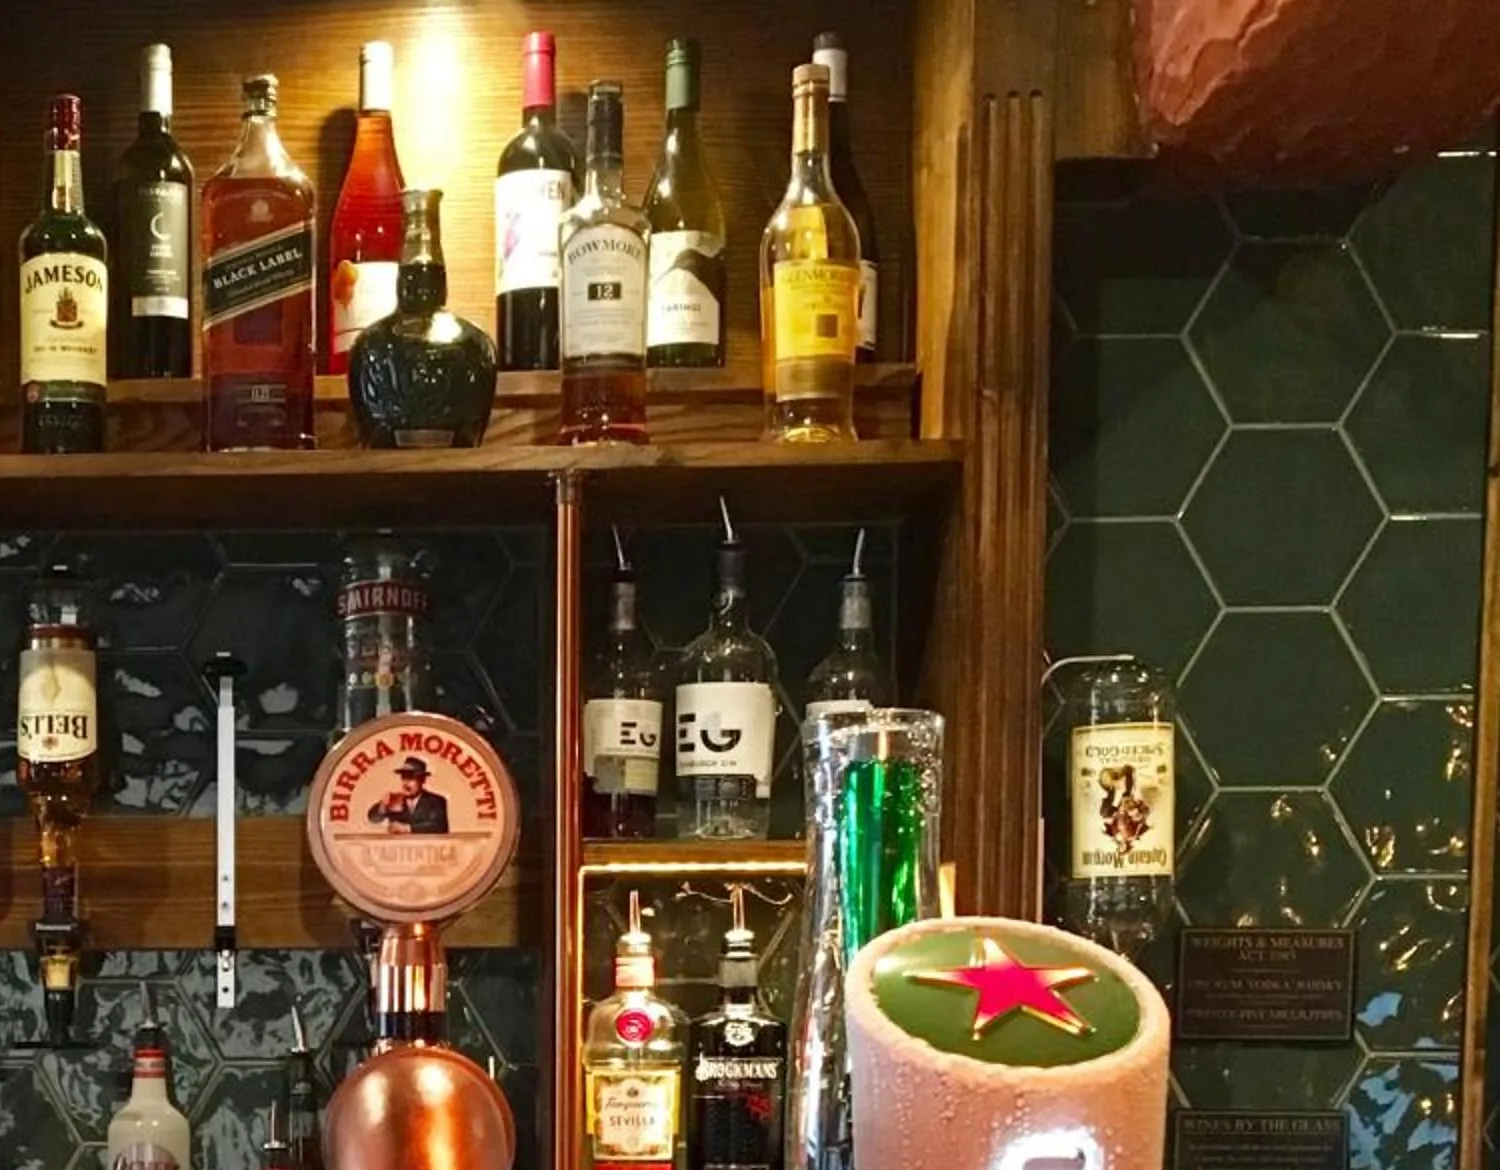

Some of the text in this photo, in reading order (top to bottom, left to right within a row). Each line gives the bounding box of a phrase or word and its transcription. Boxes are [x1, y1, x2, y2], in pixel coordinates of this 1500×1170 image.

[213, 247, 304, 290] BLACK LABEL
[595, 284, 614, 299] 12
[329, 732, 498, 823] BIRRA MORETTI
